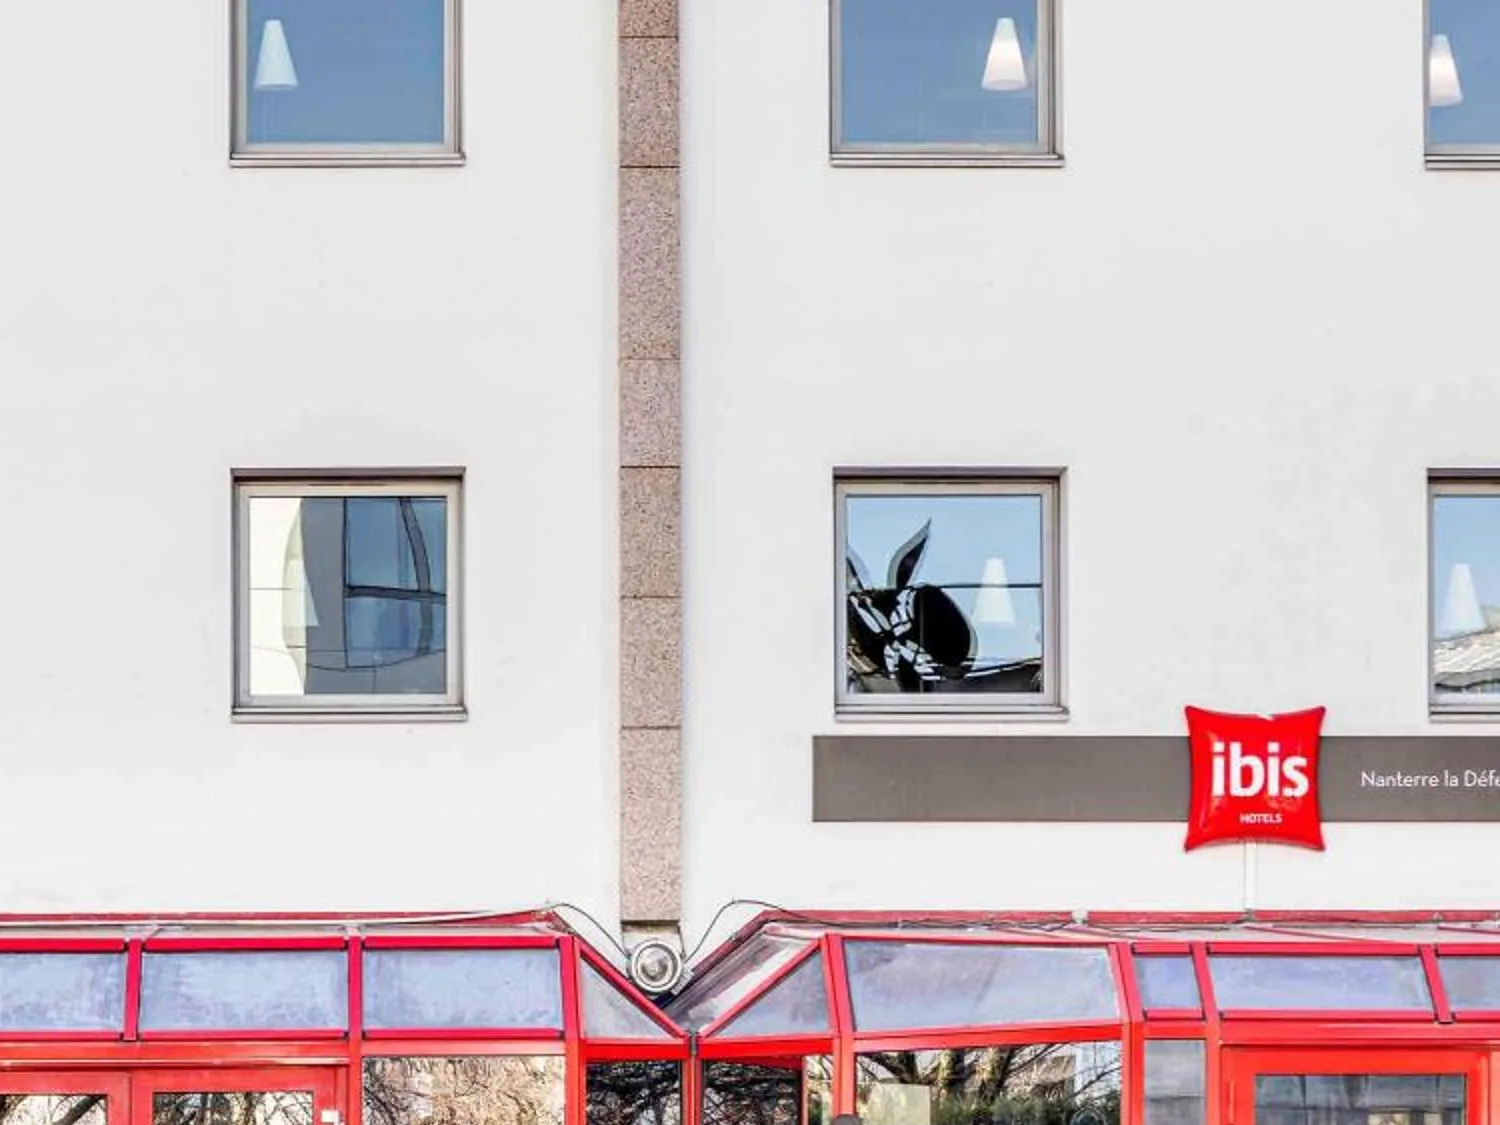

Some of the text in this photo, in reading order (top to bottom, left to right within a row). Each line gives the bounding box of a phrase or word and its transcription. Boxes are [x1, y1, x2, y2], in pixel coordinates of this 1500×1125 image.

[1212, 741, 1309, 797] ibis
[1360, 769, 1440, 788] Nanterre
[1443, 769, 1459, 788] la
[1240, 812, 1283, 824] HOTELS
